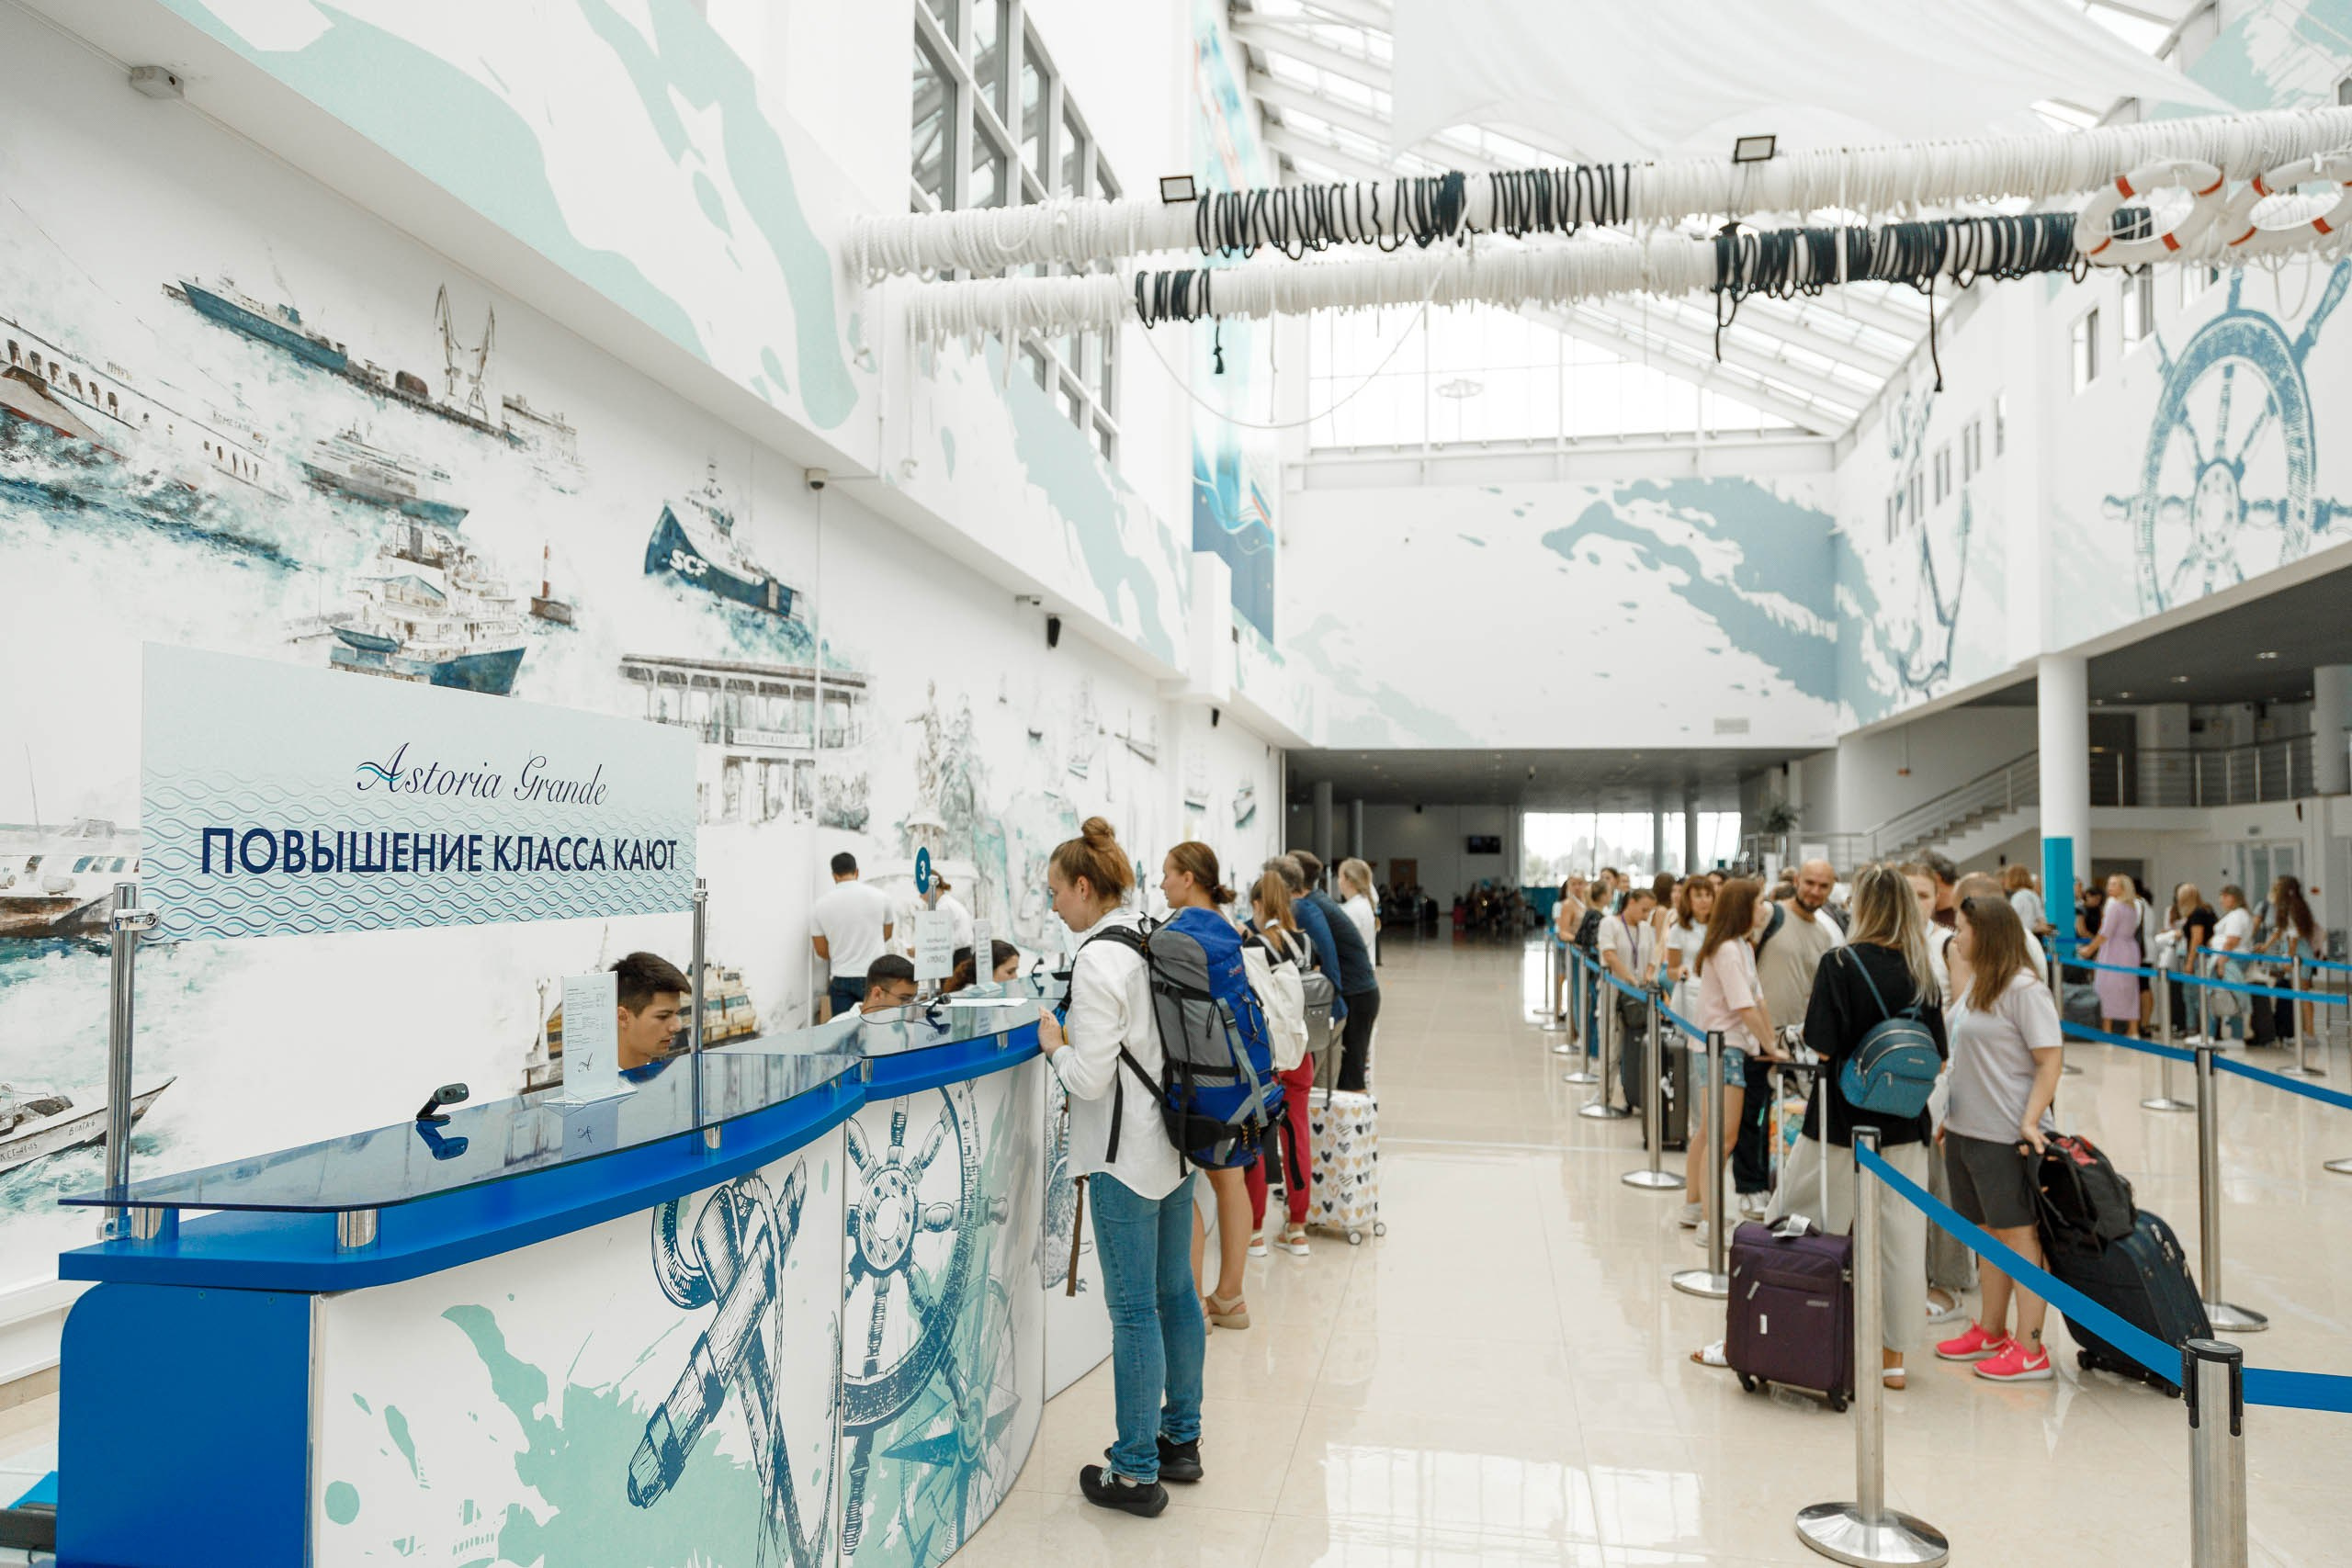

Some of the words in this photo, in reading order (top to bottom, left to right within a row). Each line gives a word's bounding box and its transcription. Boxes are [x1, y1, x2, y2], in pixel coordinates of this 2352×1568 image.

[670, 549, 708, 576] SCF
[356, 742, 504, 798] Astoria
[514, 750, 608, 805] Grande
[202, 828, 482, 874] ПОВЫШЕНИЕ
[493, 835, 606, 872] КЛАССА
[614, 838, 677, 871] КАЮТ
[920, 860, 926, 881] 3
